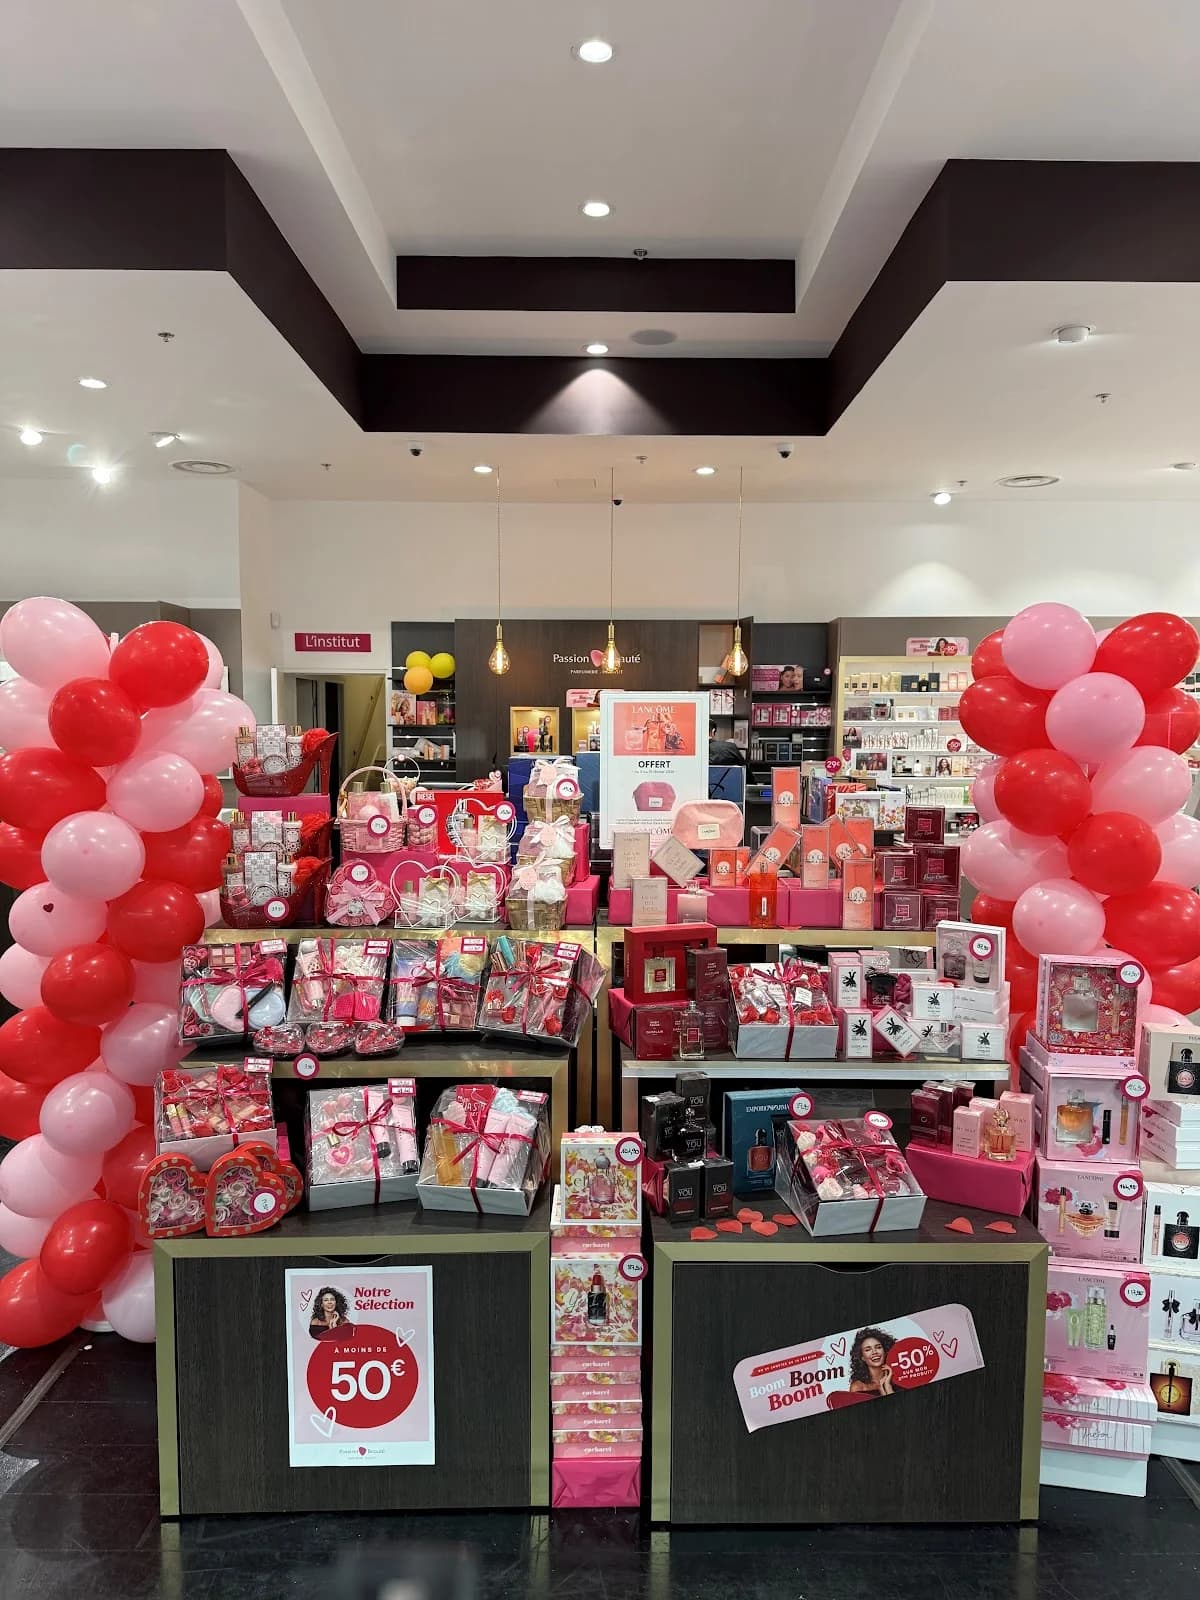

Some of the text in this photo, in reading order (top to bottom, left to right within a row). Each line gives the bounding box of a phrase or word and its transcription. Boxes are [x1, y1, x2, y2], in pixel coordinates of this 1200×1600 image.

[305, 635, 361, 648] L'institut
[553, 653, 590, 663] Passion
[638, 760, 672, 768] OFFERT
[416, 791, 435, 801] DIESEL
[712, 1183, 727, 1193] YOU
[354, 1287, 391, 1298] Notre
[354, 1298, 415, 1311] Sélection
[890, 1344, 934, 1370] -50%
[749, 1366, 845, 1399] Boom Boom
[768, 1383, 824, 1412] Boom
